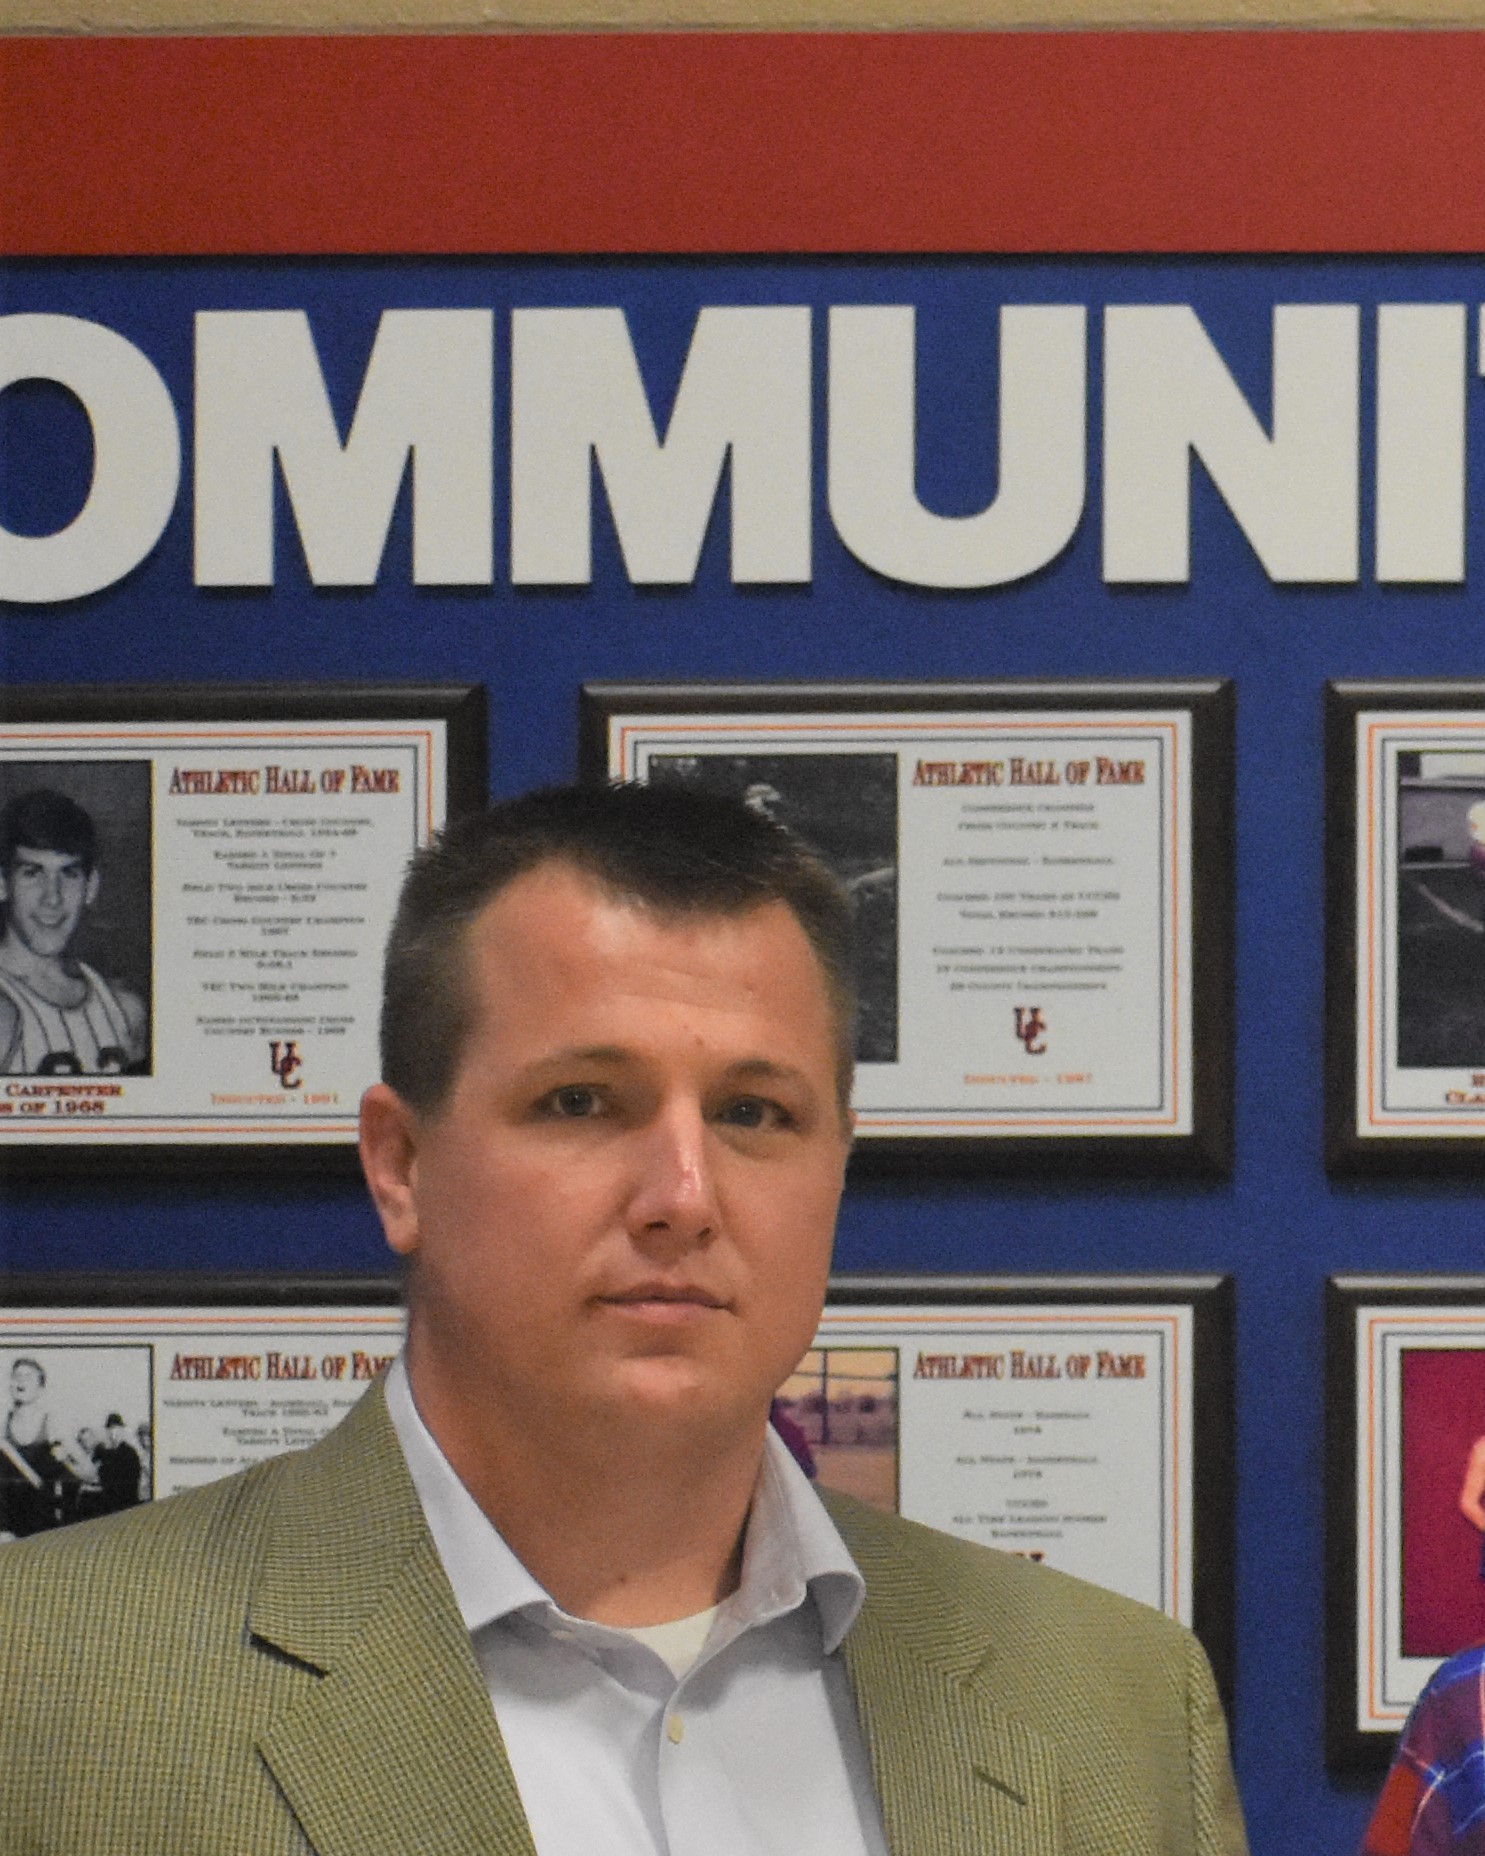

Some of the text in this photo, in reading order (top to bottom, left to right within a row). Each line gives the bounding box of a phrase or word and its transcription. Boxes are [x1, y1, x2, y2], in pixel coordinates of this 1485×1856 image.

[169, 766, 400, 795] ATHLETIC HALL OF FAME
[913, 757, 1146, 786] ATHLETIC HALL OF FAME
[20, 1101, 46, 1114] OF
[171, 1353, 262, 1381] ATHLETIC
[267, 1353, 316, 1381] HALL
[322, 1357, 344, 1381] OF
[914, 1350, 1146, 1379] ATHLETIC HALL OF FAME
